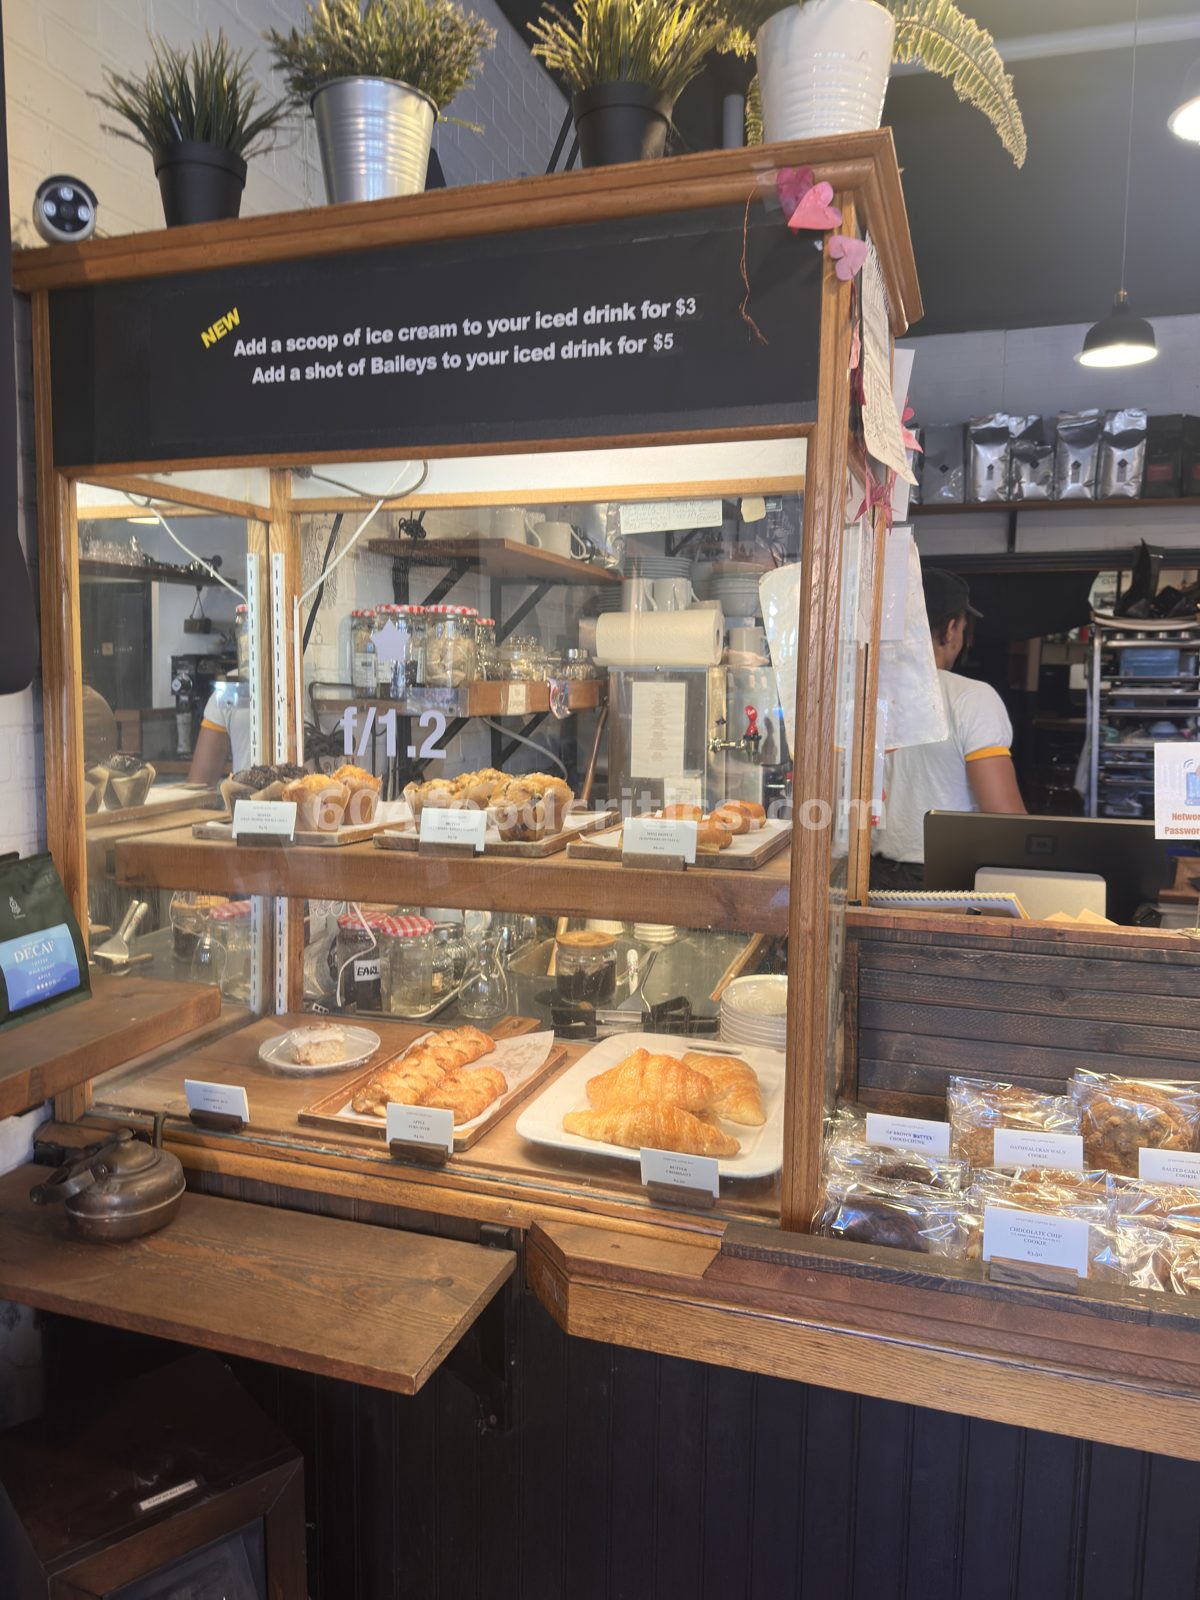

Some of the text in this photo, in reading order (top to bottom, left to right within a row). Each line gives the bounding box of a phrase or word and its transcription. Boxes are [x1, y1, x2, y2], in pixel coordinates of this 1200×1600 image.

[201, 307, 240, 348] NEW
[233, 297, 697, 357] Add a scoop of ice cream to your iced drink for $3
[251, 332, 674, 384] Add a shot of Baileys to your iced drink for $5
[339, 706, 447, 760] f/1.2
[14, 940, 55, 964] DECAF
[1009, 1226, 1047, 1237] CHOCOLATE
[1047, 1231, 1063, 1239] CHIP
[1023, 1238, 1048, 1246] COOKIE
